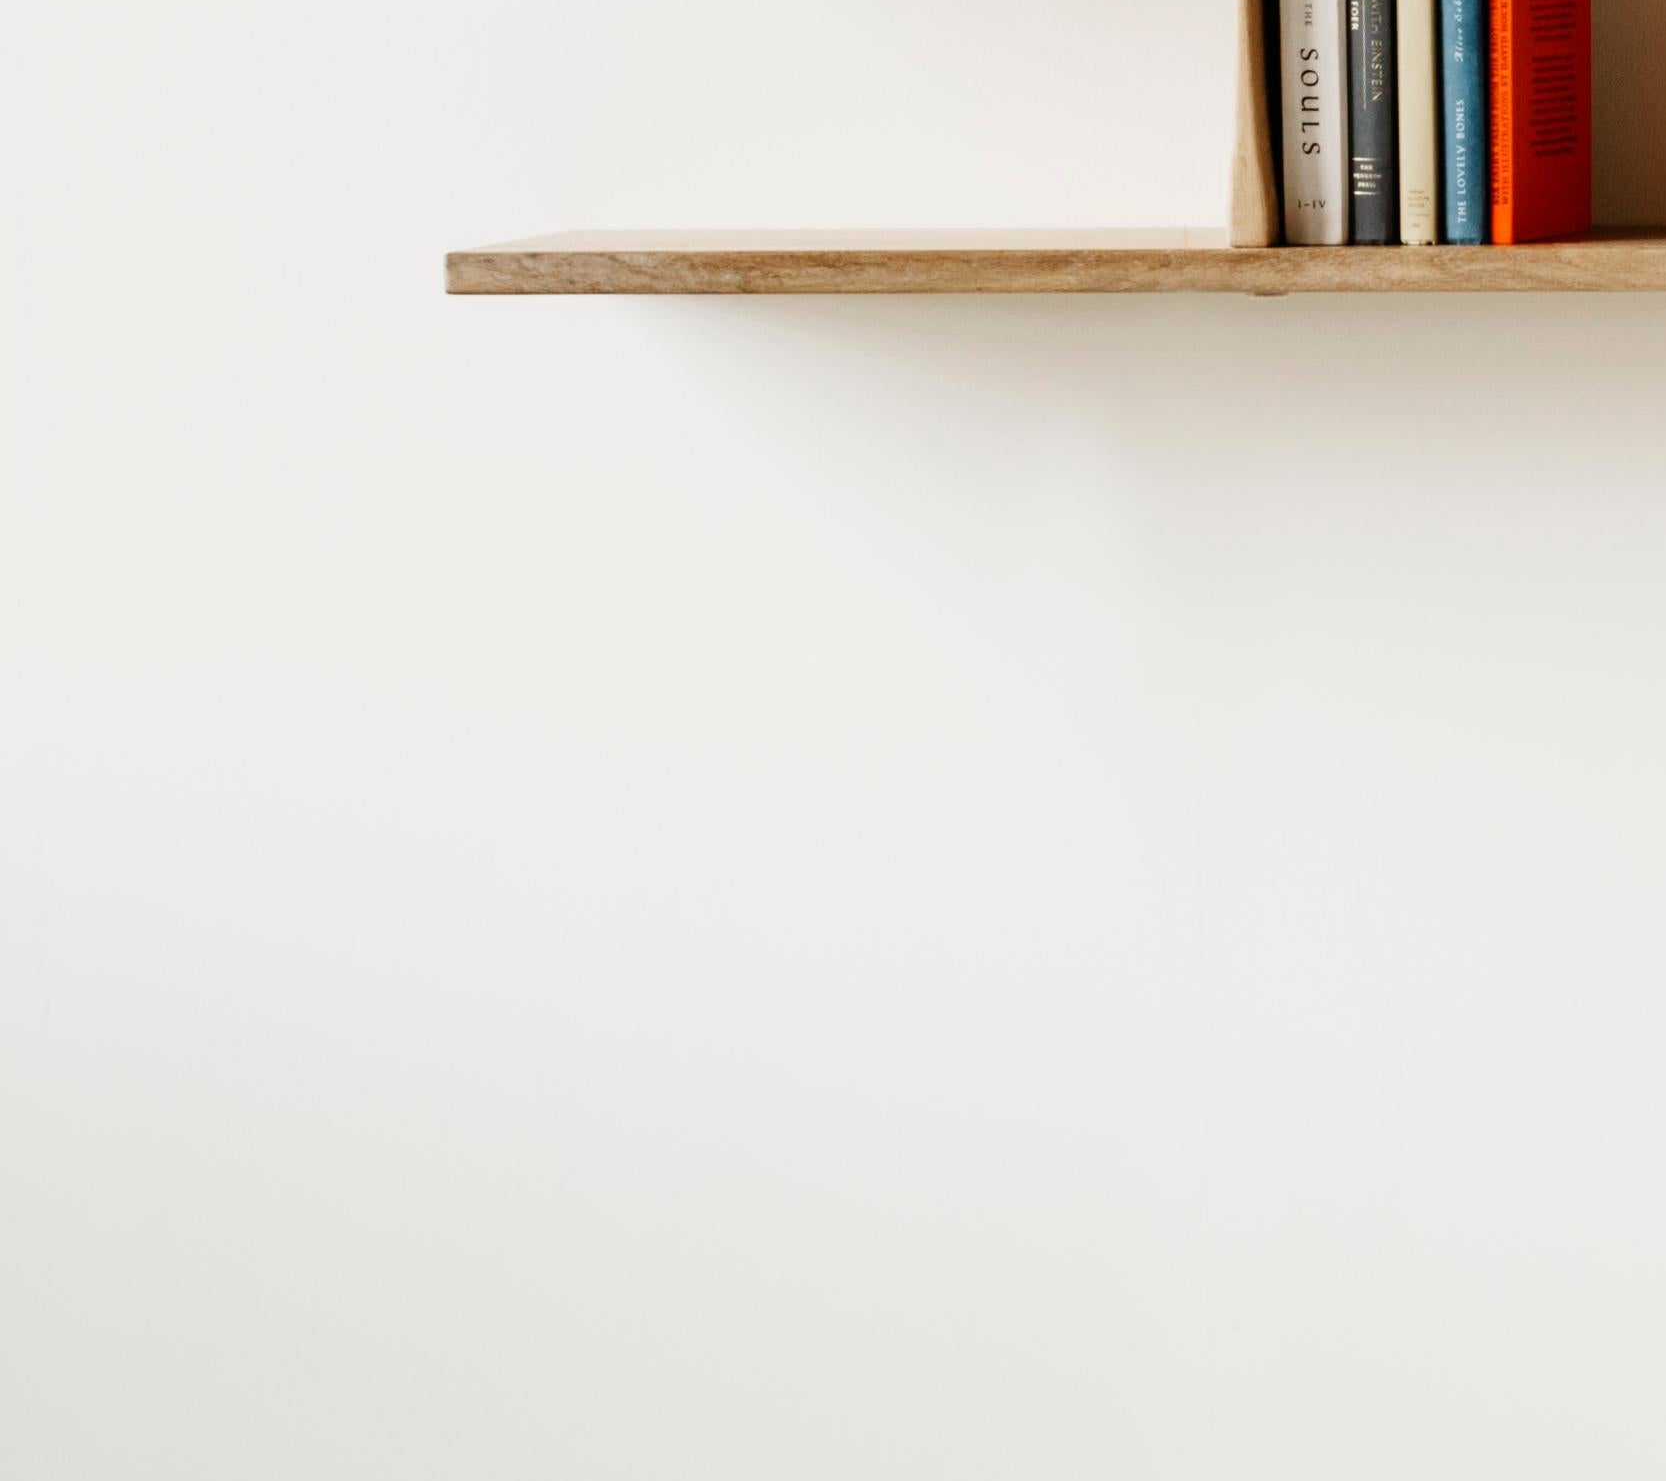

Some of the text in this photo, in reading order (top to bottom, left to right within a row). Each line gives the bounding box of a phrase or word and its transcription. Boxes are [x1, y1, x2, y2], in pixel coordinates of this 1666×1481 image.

[1350, 1, 1360, 31] FOER
[1454, 29, 1464, 63] Alice
[1500, 35, 1508, 70] DAVID
[1300, 3, 1321, 155] THE SOULS
[1371, 39, 1384, 102] EINSTEIN
[1500, 74, 1508, 87] BY
[1501, 90, 1509, 173] ILLUSTRATIONS
[1455, 99, 1467, 223] THE LOVELY BONES
[1501, 176, 1510, 206] WITH
